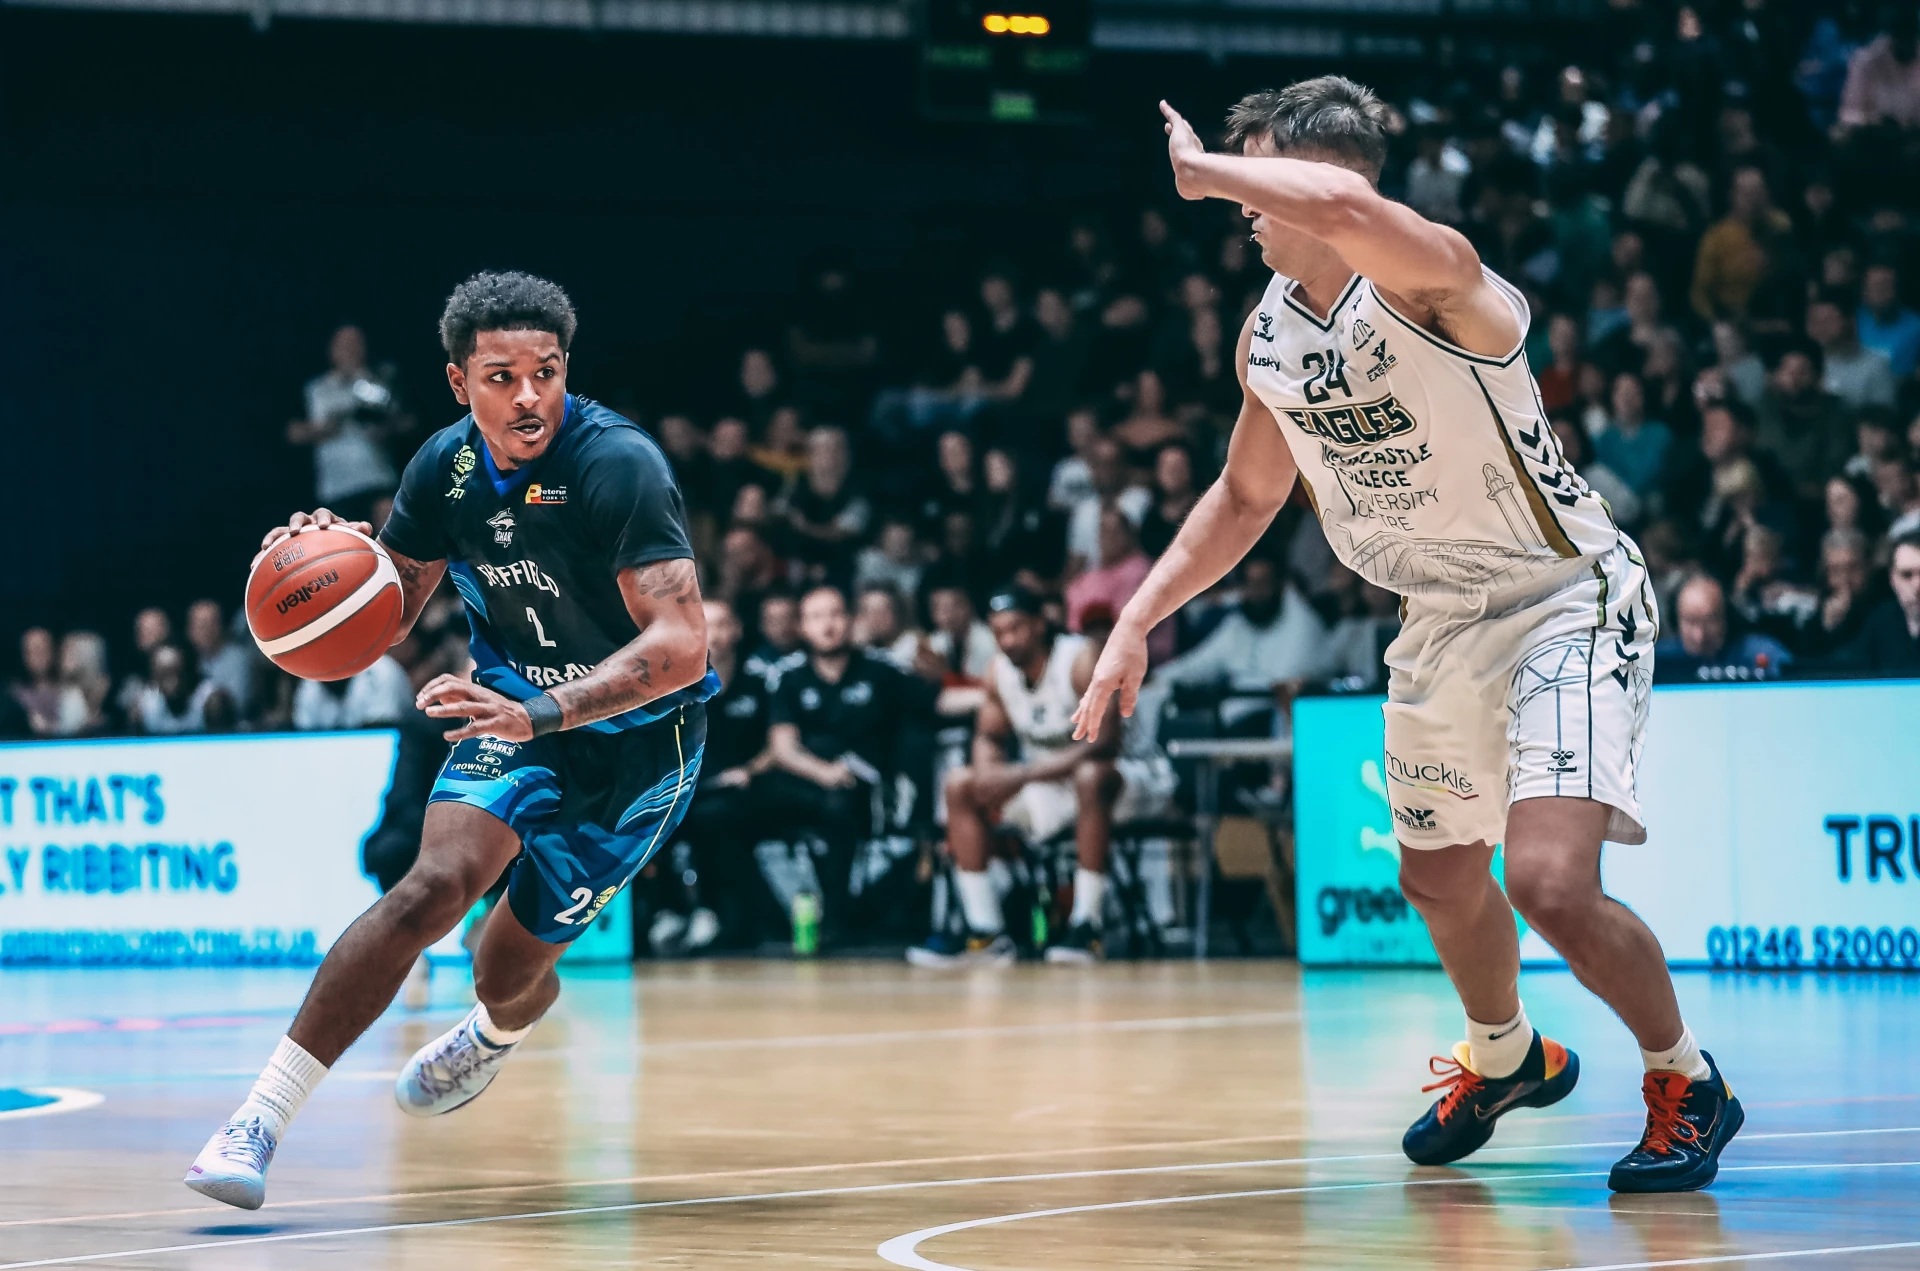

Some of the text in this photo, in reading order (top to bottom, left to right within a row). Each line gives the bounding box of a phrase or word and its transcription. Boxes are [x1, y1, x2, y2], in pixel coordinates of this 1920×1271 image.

[1247, 352, 1281, 372] lusky
[1302, 349, 1353, 405] 24
[1367, 354, 1397, 382] EAGES
[1281, 396, 1414, 447] EAGLES
[1357, 499, 1415, 531] CETRE
[1358, 488, 1439, 511] VERSITY
[275, 569, 340, 615] molten
[525, 606, 557, 648] 2
[480, 740, 516, 757] SHARKS
[450, 762, 490, 774] CROWNE
[491, 767, 520, 788] PLAZA
[1385, 750, 1473, 793] muckle
[29, 774, 165, 825] THAT'S
[43, 842, 239, 893] RIBBITING
[554, 886, 593, 924] 2
[1707, 926, 1802, 967] 01246
